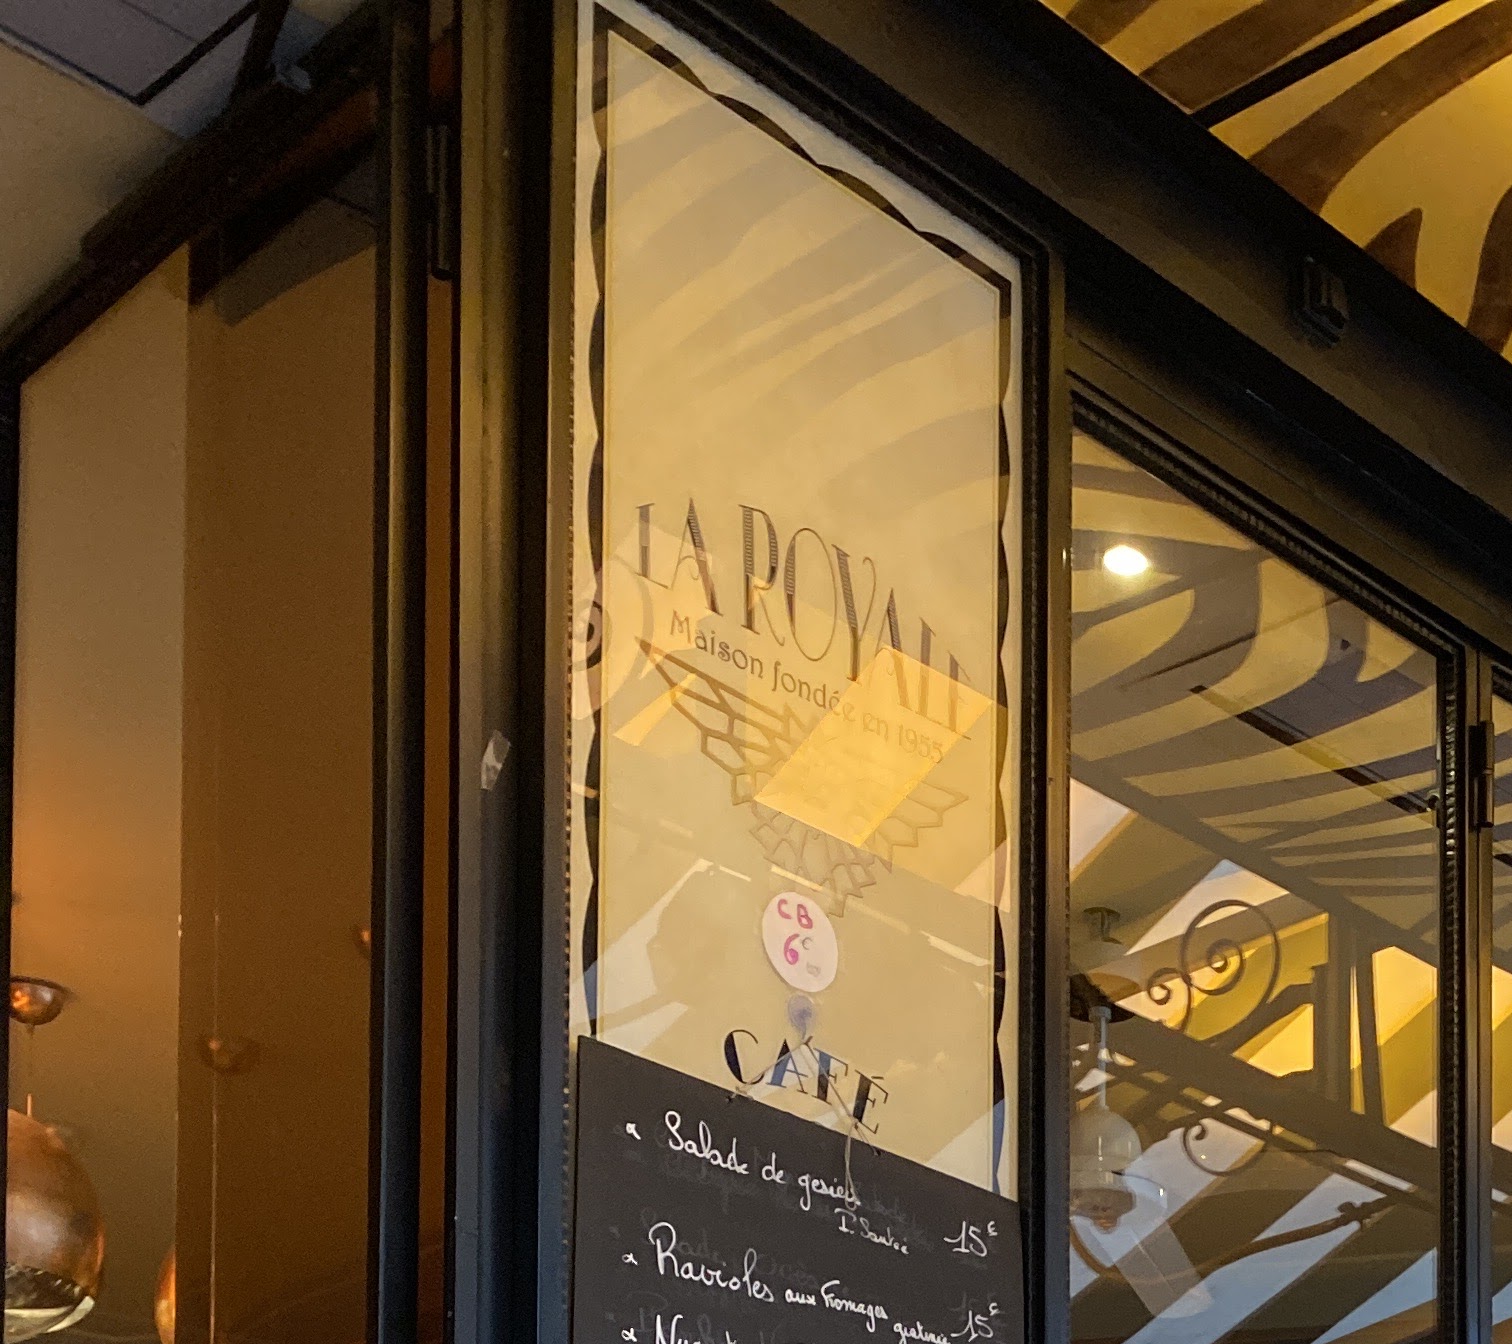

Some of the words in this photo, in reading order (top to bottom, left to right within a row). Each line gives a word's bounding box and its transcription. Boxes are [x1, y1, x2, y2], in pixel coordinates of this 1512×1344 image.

[632, 498, 723, 617] LA
[738, 503, 972, 741] ROYALE
[669, 609, 764, 679] Maison
[771, 660, 857, 723] fondée
[777, 898, 813, 930] CB
[724, 1028, 890, 1136] CAFÉ
[664, 1110, 749, 1175] Salade
[761, 1151, 787, 1184] de
[649, 1221, 775, 1303] Ravioles
[784, 1288, 817, 1306] aux
[820, 1279, 889, 1333] Fromages
